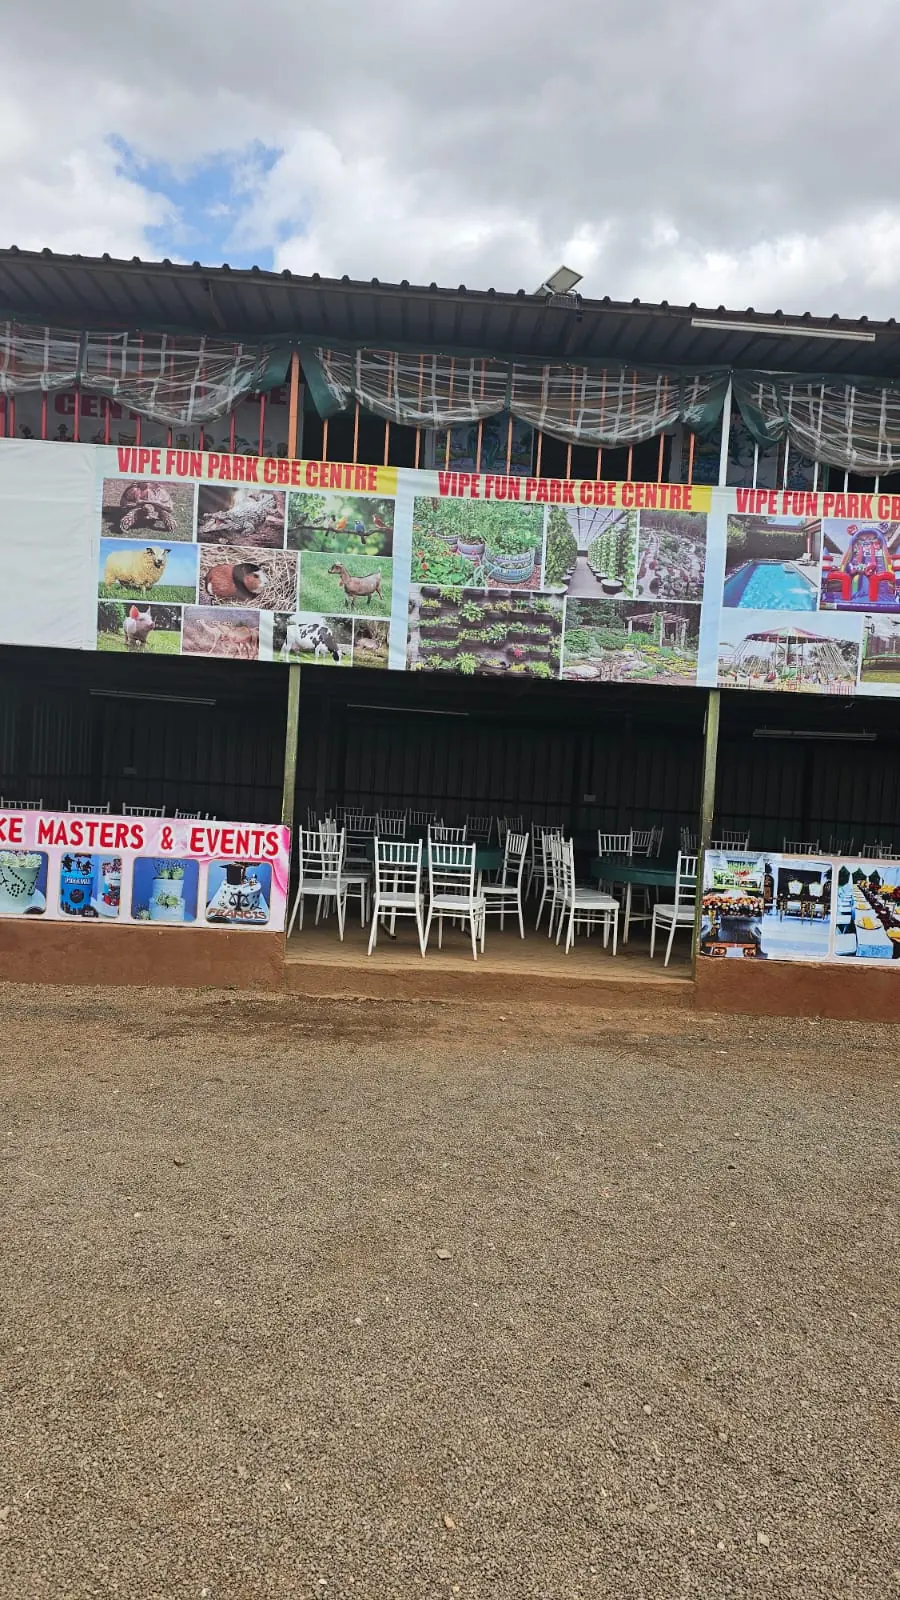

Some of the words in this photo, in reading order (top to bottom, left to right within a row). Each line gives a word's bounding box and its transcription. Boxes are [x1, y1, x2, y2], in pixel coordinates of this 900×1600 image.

[117, 447, 161, 475] VIPE
[166, 449, 203, 478] FUN
[207, 453, 259, 483] PARK
[263, 458, 301, 486] CBE
[305, 462, 378, 491] CENTRE
[438, 471, 480, 499] VIPE
[484, 475, 521, 501] FUN
[525, 477, 576, 504] PARK
[580, 481, 617, 506] CBE
[621, 482, 693, 511] CENTRE
[736, 487, 779, 515] VIPE
[782, 490, 818, 517] FUN
[822, 493, 873, 519] PARK
[878, 495, 900, 520] CB
[38, 819, 144, 849] MASTERS
[160, 826, 174, 850] &
[189, 827, 279, 856] EVENTS
